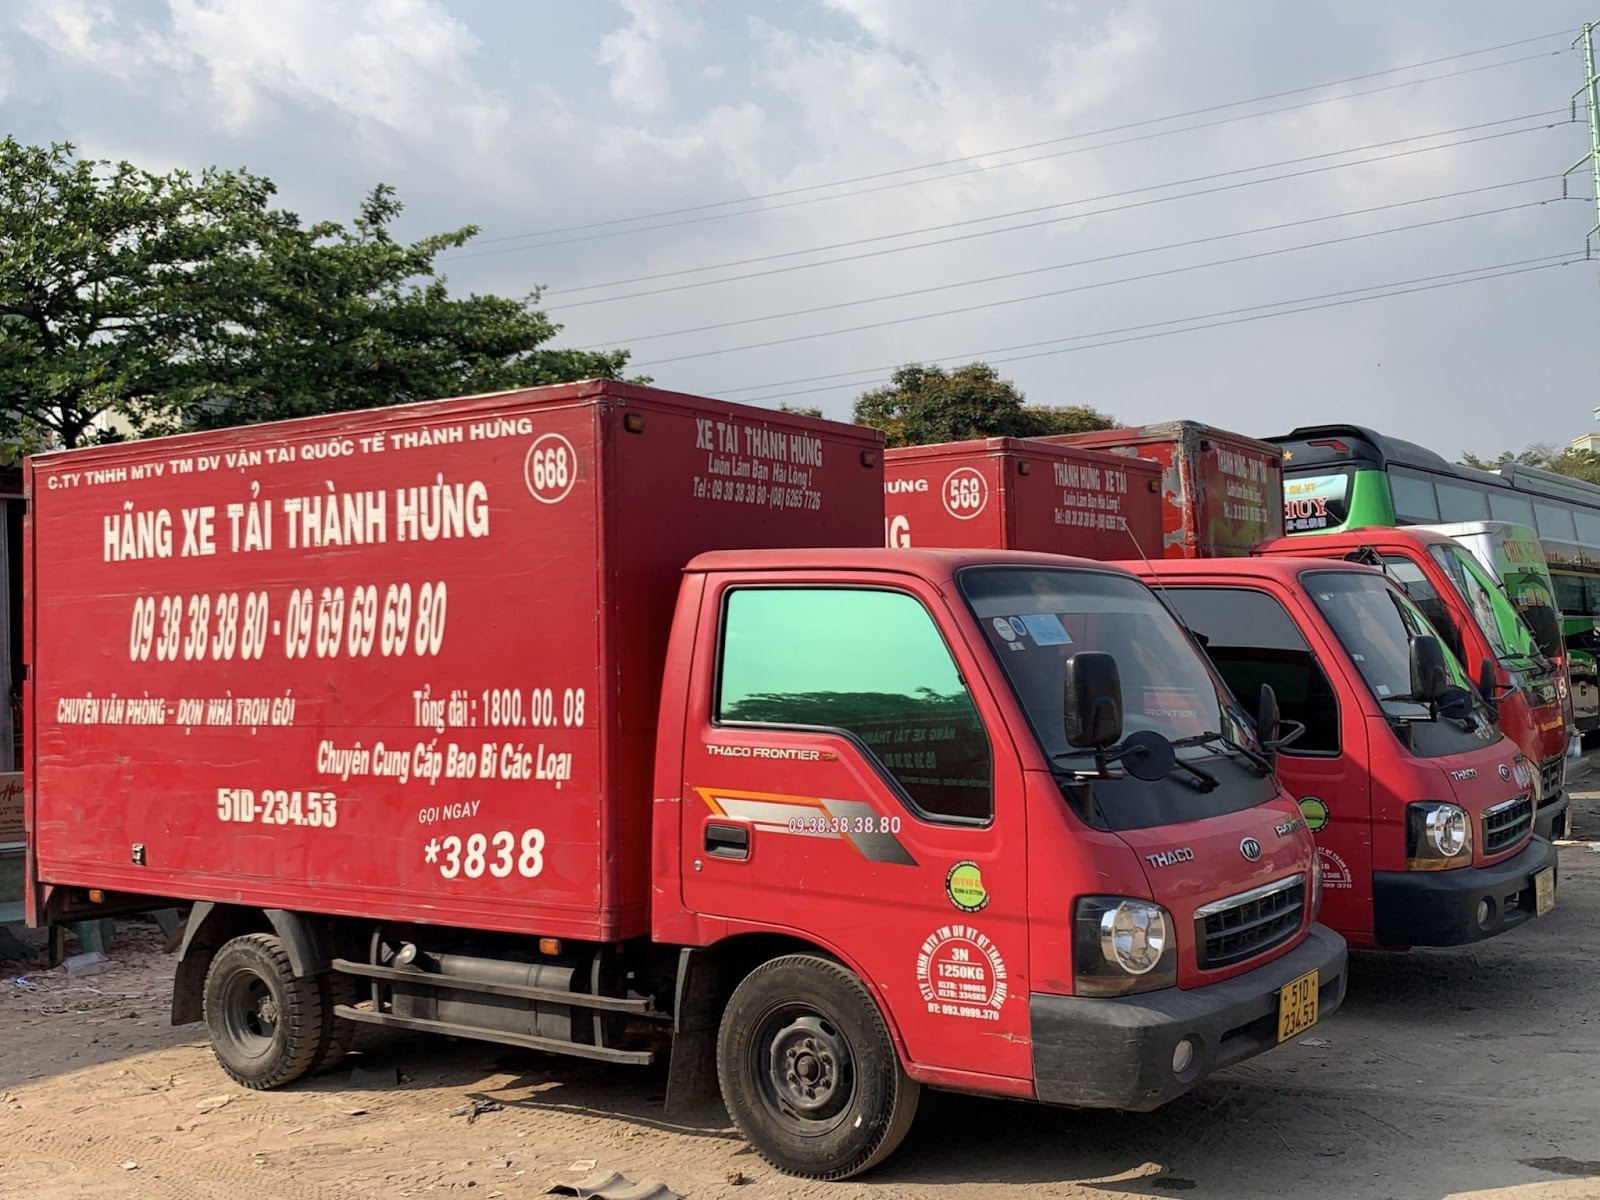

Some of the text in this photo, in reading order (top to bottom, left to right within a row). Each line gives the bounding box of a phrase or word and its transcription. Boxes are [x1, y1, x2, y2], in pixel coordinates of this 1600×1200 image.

[696, 418, 714, 451] XE
[744, 422, 787, 461] THÀNH
[48, 472, 79, 490] C.TY
[85, 467, 126, 484] TNHH
[131, 462, 164, 480] MTV
[169, 458, 193, 474] TM
[198, 455, 220, 471] DV
[225, 449, 261, 474] VẬN
[301, 436, 354, 460] QUỐC
[360, 431, 386, 454] TẾ
[391, 425, 463, 450] THÀNH
[470, 418, 533, 441] HƯNG
[708, 452, 730, 476] Luôn
[732, 456, 750, 478] Làm
[532, 446, 568, 490] 668
[884, 478, 928, 494] ƯNG
[104, 472, 489, 562] HÃNG XE TẢI THÀNH HƯNG
[130, 596, 155, 662] 09
[156, 595, 183, 661] 38
[184, 593, 210, 661] 38
[212, 592, 239, 661] 38
[241, 590, 269, 660] 80
[285, 588, 313, 659] 09
[316, 586, 345, 659] 69
[348, 584, 378, 658] 69
[381, 582, 412, 657] 69
[414, 580, 447, 656] 80
[57, 692, 100, 725] CHUYÊN
[100, 693, 125, 725] VĂN
[206, 690, 233, 726] NHÀ
[235, 698, 270, 735] TRỌN
[413, 683, 445, 733] Tổng
[449, 690, 468, 727] đài
[563, 688, 585, 727] 08
[317, 738, 572, 790] Chuyên Cung Cấp Bao Bì Các Loại
[706, 745, 751, 758] THACO
[753, 748, 820, 761] FRONTIER
[217, 788, 338, 828] 51D-234.53
[418, 799, 481, 826] GỌI NGAY
[788, 816, 901, 834] 09.38.38.38.80
[1145, 847, 1194, 869] THACO
[1244, 841, 1261, 857] KIA
[921, 933, 939, 955] MTV
[936, 925, 952, 940] TM
[966, 926, 978, 940] VT
[977, 934, 990, 949] QT
[917, 952, 929, 980] TNHH
[951, 948, 969, 961] 3N
[938, 964, 984, 980] 1250KG
[919, 983, 934, 1002] CTY
[942, 1004, 999, 1020] 093.9999.370
[1284, 1001, 1315, 1037] 234.53
